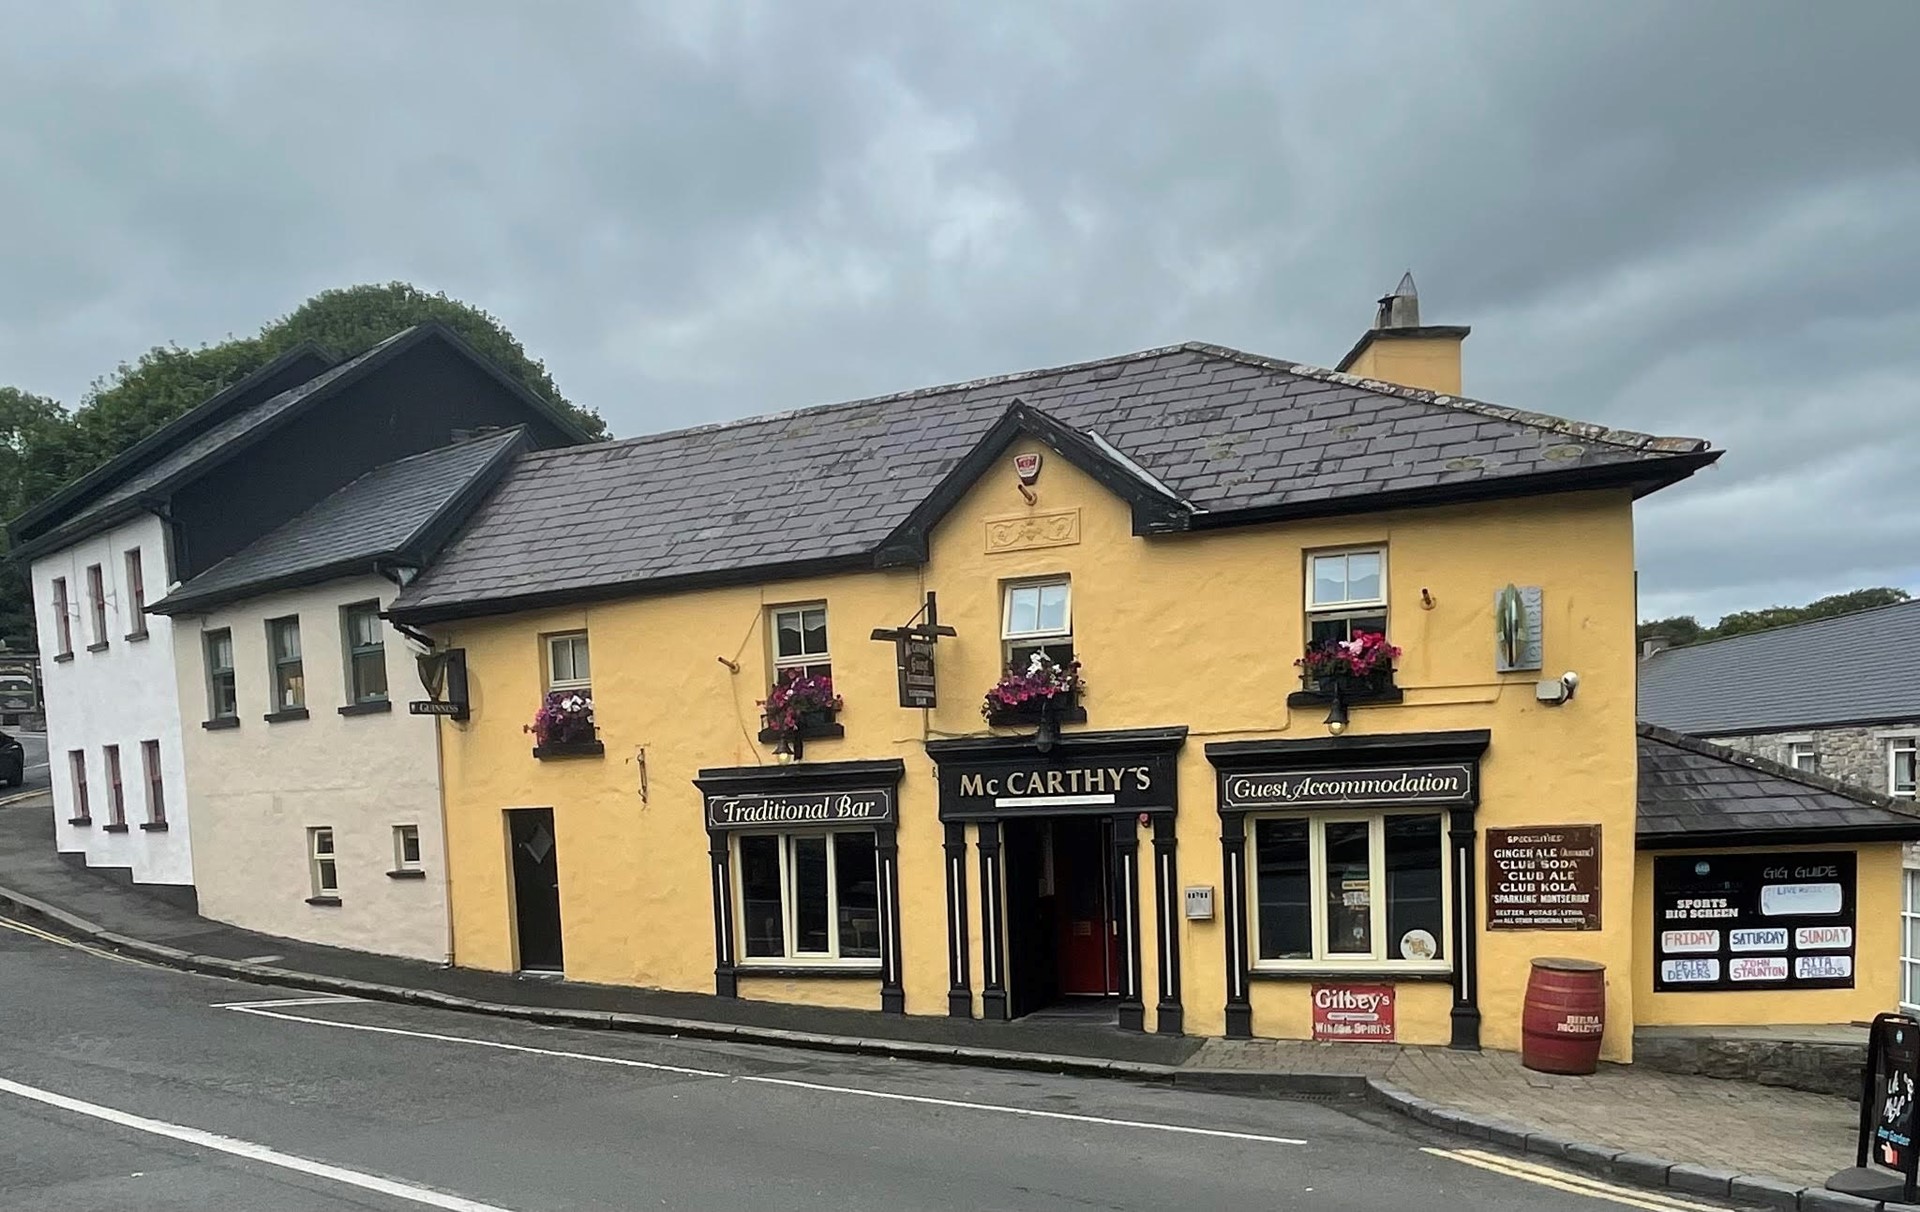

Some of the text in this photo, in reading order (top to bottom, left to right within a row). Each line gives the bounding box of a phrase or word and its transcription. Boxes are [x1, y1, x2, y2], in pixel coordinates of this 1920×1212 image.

[419, 703, 459, 712] GUINNESS
[1234, 773, 1458, 801] Guest Accommodation
[722, 793, 876, 823] Traditional Bar
[1494, 848, 1533, 858] GINGER
[1535, 848, 1557, 858] ALE
[1795, 865, 1839, 878] GUIDE
[1677, 899, 1727, 909] SPORTS
[1665, 908, 1739, 919] BIG SCREEN
[1665, 931, 1715, 946] FRIDAY
[1732, 931, 1785, 945] SATURDAY
[1800, 929, 1849, 944] SUNDAY
[1675, 960, 1708, 971] PETER
[1740, 959, 1770, 969] JOHN
[1802, 957, 1832, 968] RITA
[1734, 967, 1785, 979] STAUNTON
[1800, 967, 1845, 977] FRIENDS
[1315, 988, 1390, 1013] Gilbey's
[1566, 1015, 1599, 1024] BIRRA
[1354, 1022, 1392, 1035] SPIRITS
